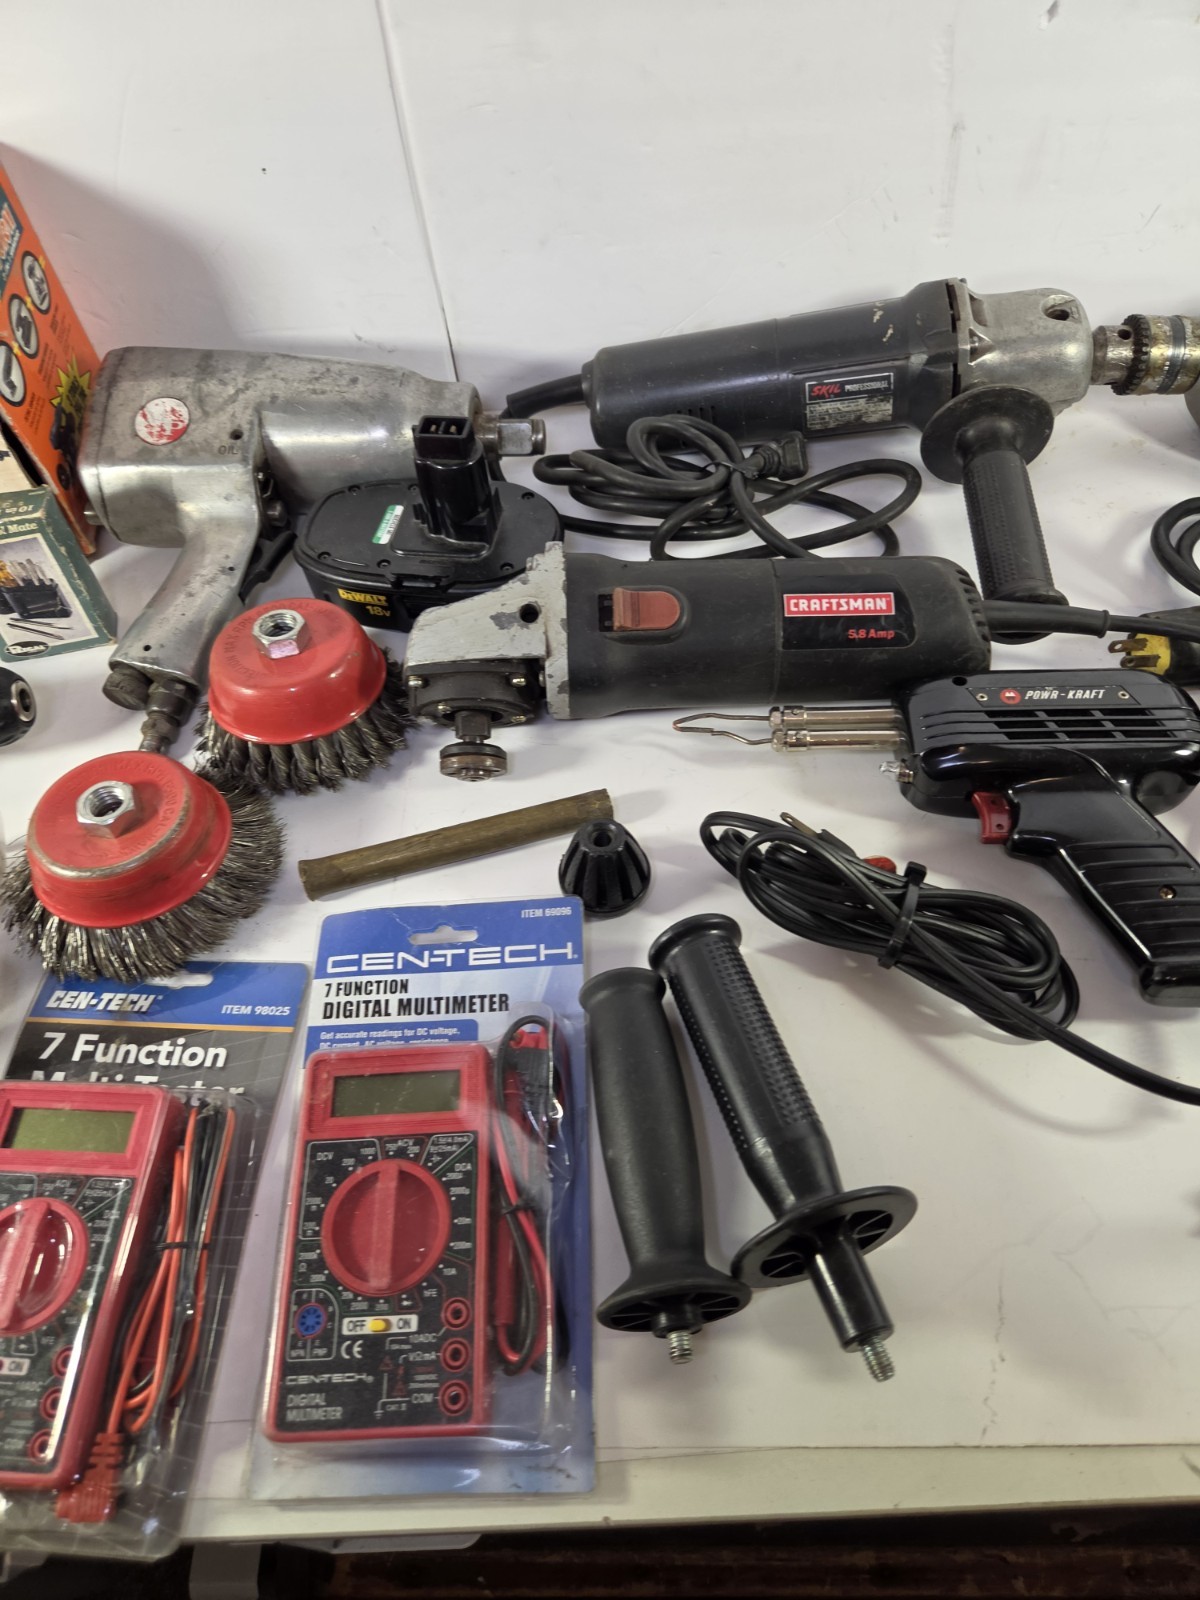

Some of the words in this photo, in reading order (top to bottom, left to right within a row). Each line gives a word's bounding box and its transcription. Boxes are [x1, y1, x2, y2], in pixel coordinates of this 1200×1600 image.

[811, 384, 842, 398] SKIL
[218, 445, 239, 455] OIL
[790, 598, 888, 611] CRAFTSMAN
[848, 629, 867, 639] 5.8
[868, 629, 895, 639] Amp
[521, 908, 543, 918] ITEM
[327, 942, 572, 973] CEN-TECH
[325, 983, 332, 997] 7
[336, 978, 409, 997] FUNCTION
[221, 1004, 251, 1015] ITEM
[254, 1005, 290, 1016] 98025
[323, 1000, 391, 1019] DIGITAL
[397, 993, 509, 1017] MULTIMETER
[335, 1031, 368, 1039] accurate
[369, 1030, 403, 1038] readings
[39, 1032, 67, 1060] 7
[71, 1034, 228, 1068] Function
[316, 1152, 334, 1161] DCV
[347, 1320, 366, 1332] OFF
[396, 1318, 412, 1329] ON
[286, 1392, 327, 1407] DIGITAL
[286, 1407, 343, 1422] MULTIMETER
